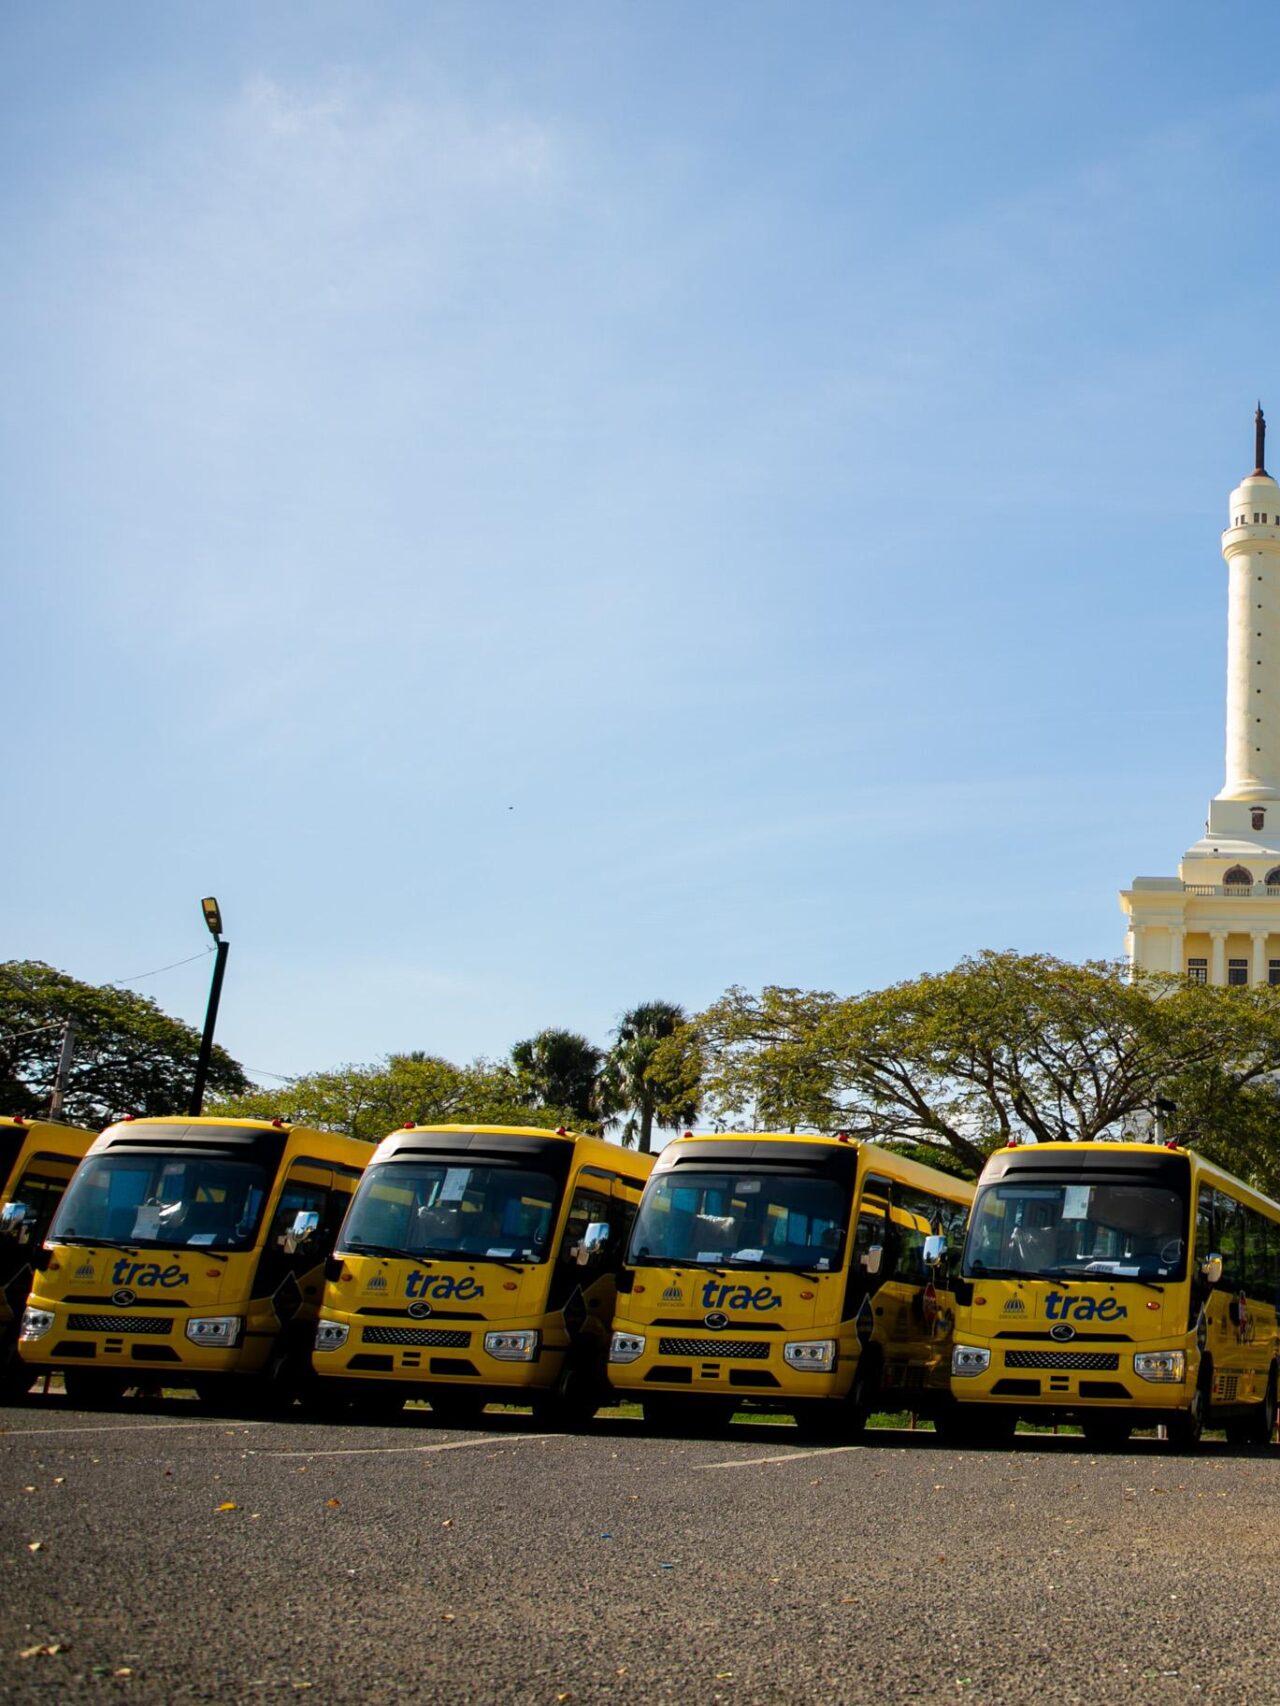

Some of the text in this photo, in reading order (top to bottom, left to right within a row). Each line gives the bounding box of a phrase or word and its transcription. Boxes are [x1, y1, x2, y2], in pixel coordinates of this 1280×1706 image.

[112, 1258, 189, 1288] trae
[405, 1270, 484, 1300] trae
[702, 1280, 782, 1311] trae
[1044, 1291, 1127, 1321] trae
